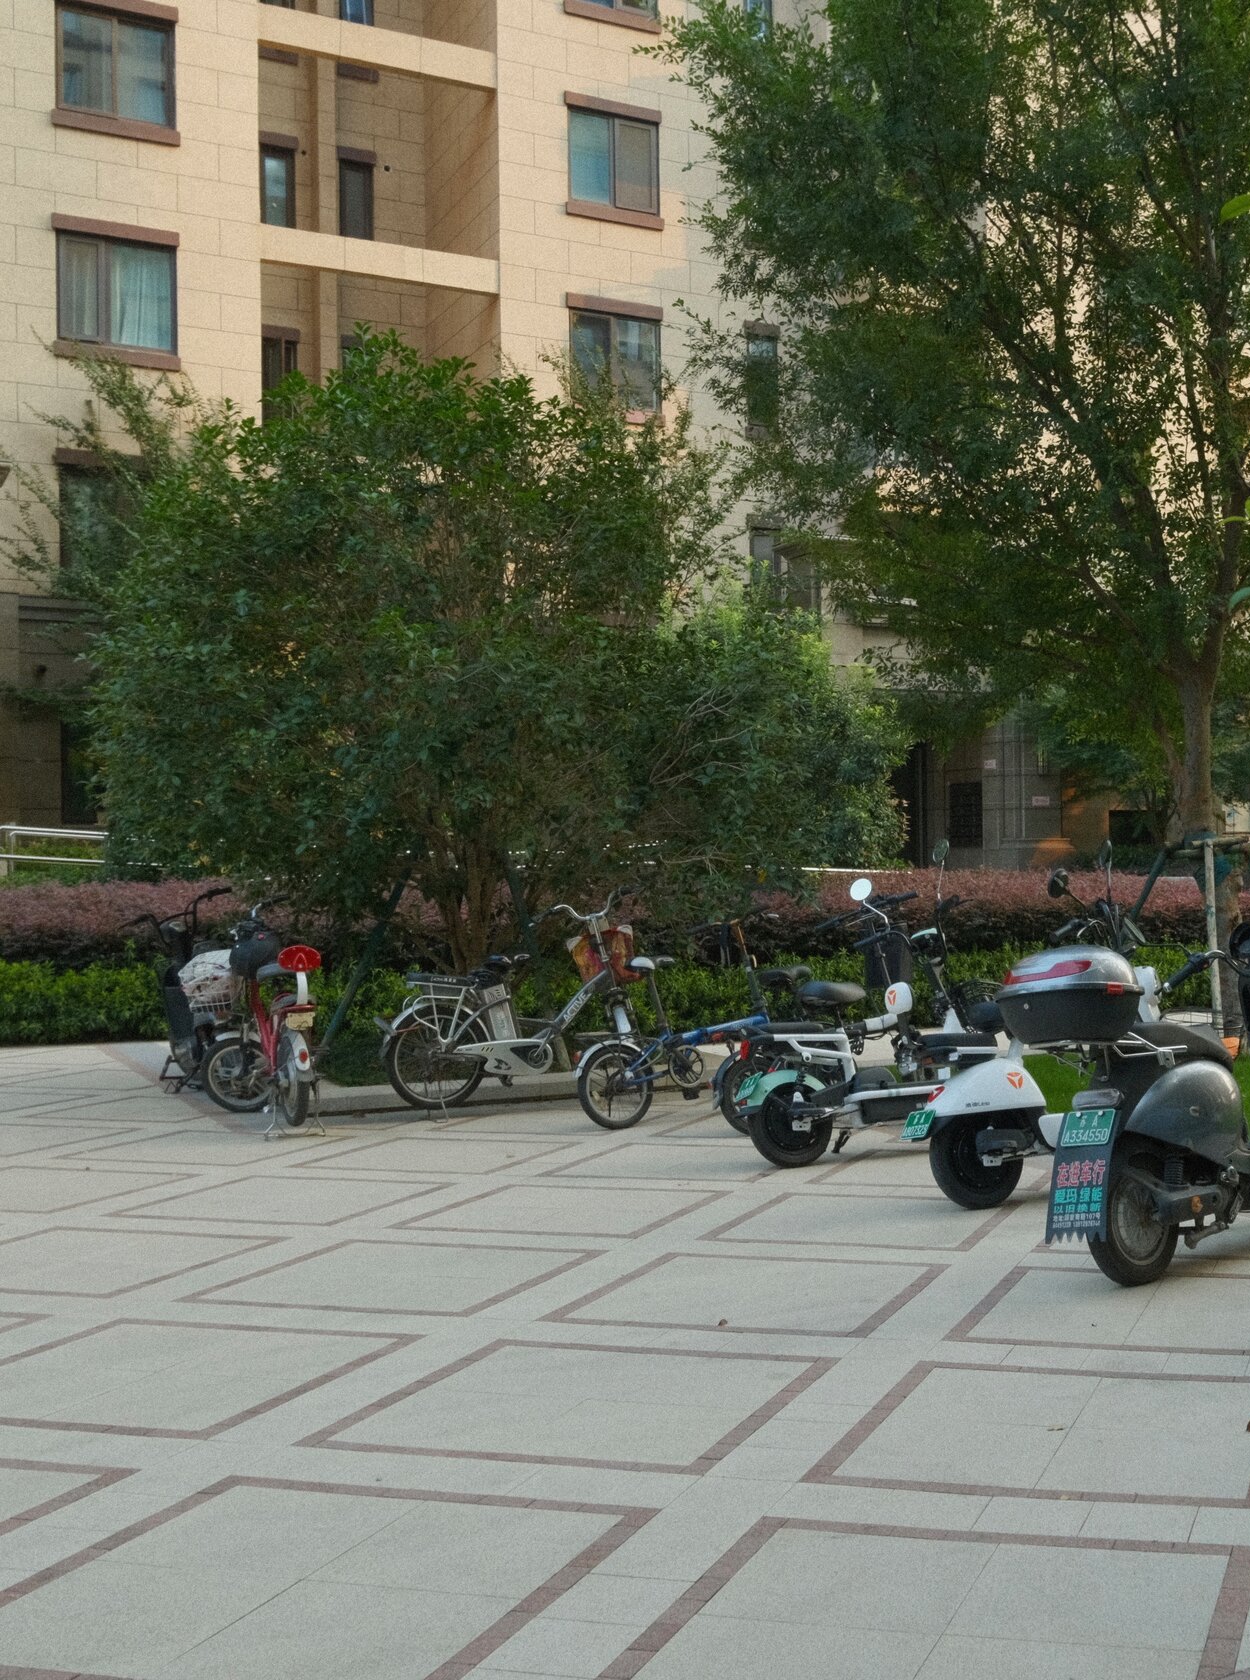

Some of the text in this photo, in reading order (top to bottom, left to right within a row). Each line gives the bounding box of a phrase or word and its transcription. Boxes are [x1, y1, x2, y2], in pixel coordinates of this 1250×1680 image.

[563, 992, 586, 1022] ACTIVE
[1091, 1115, 1099, 1128] A
[1064, 1128, 1108, 1143] A334550
[1054, 1203, 1101, 1213] 以旧换新
